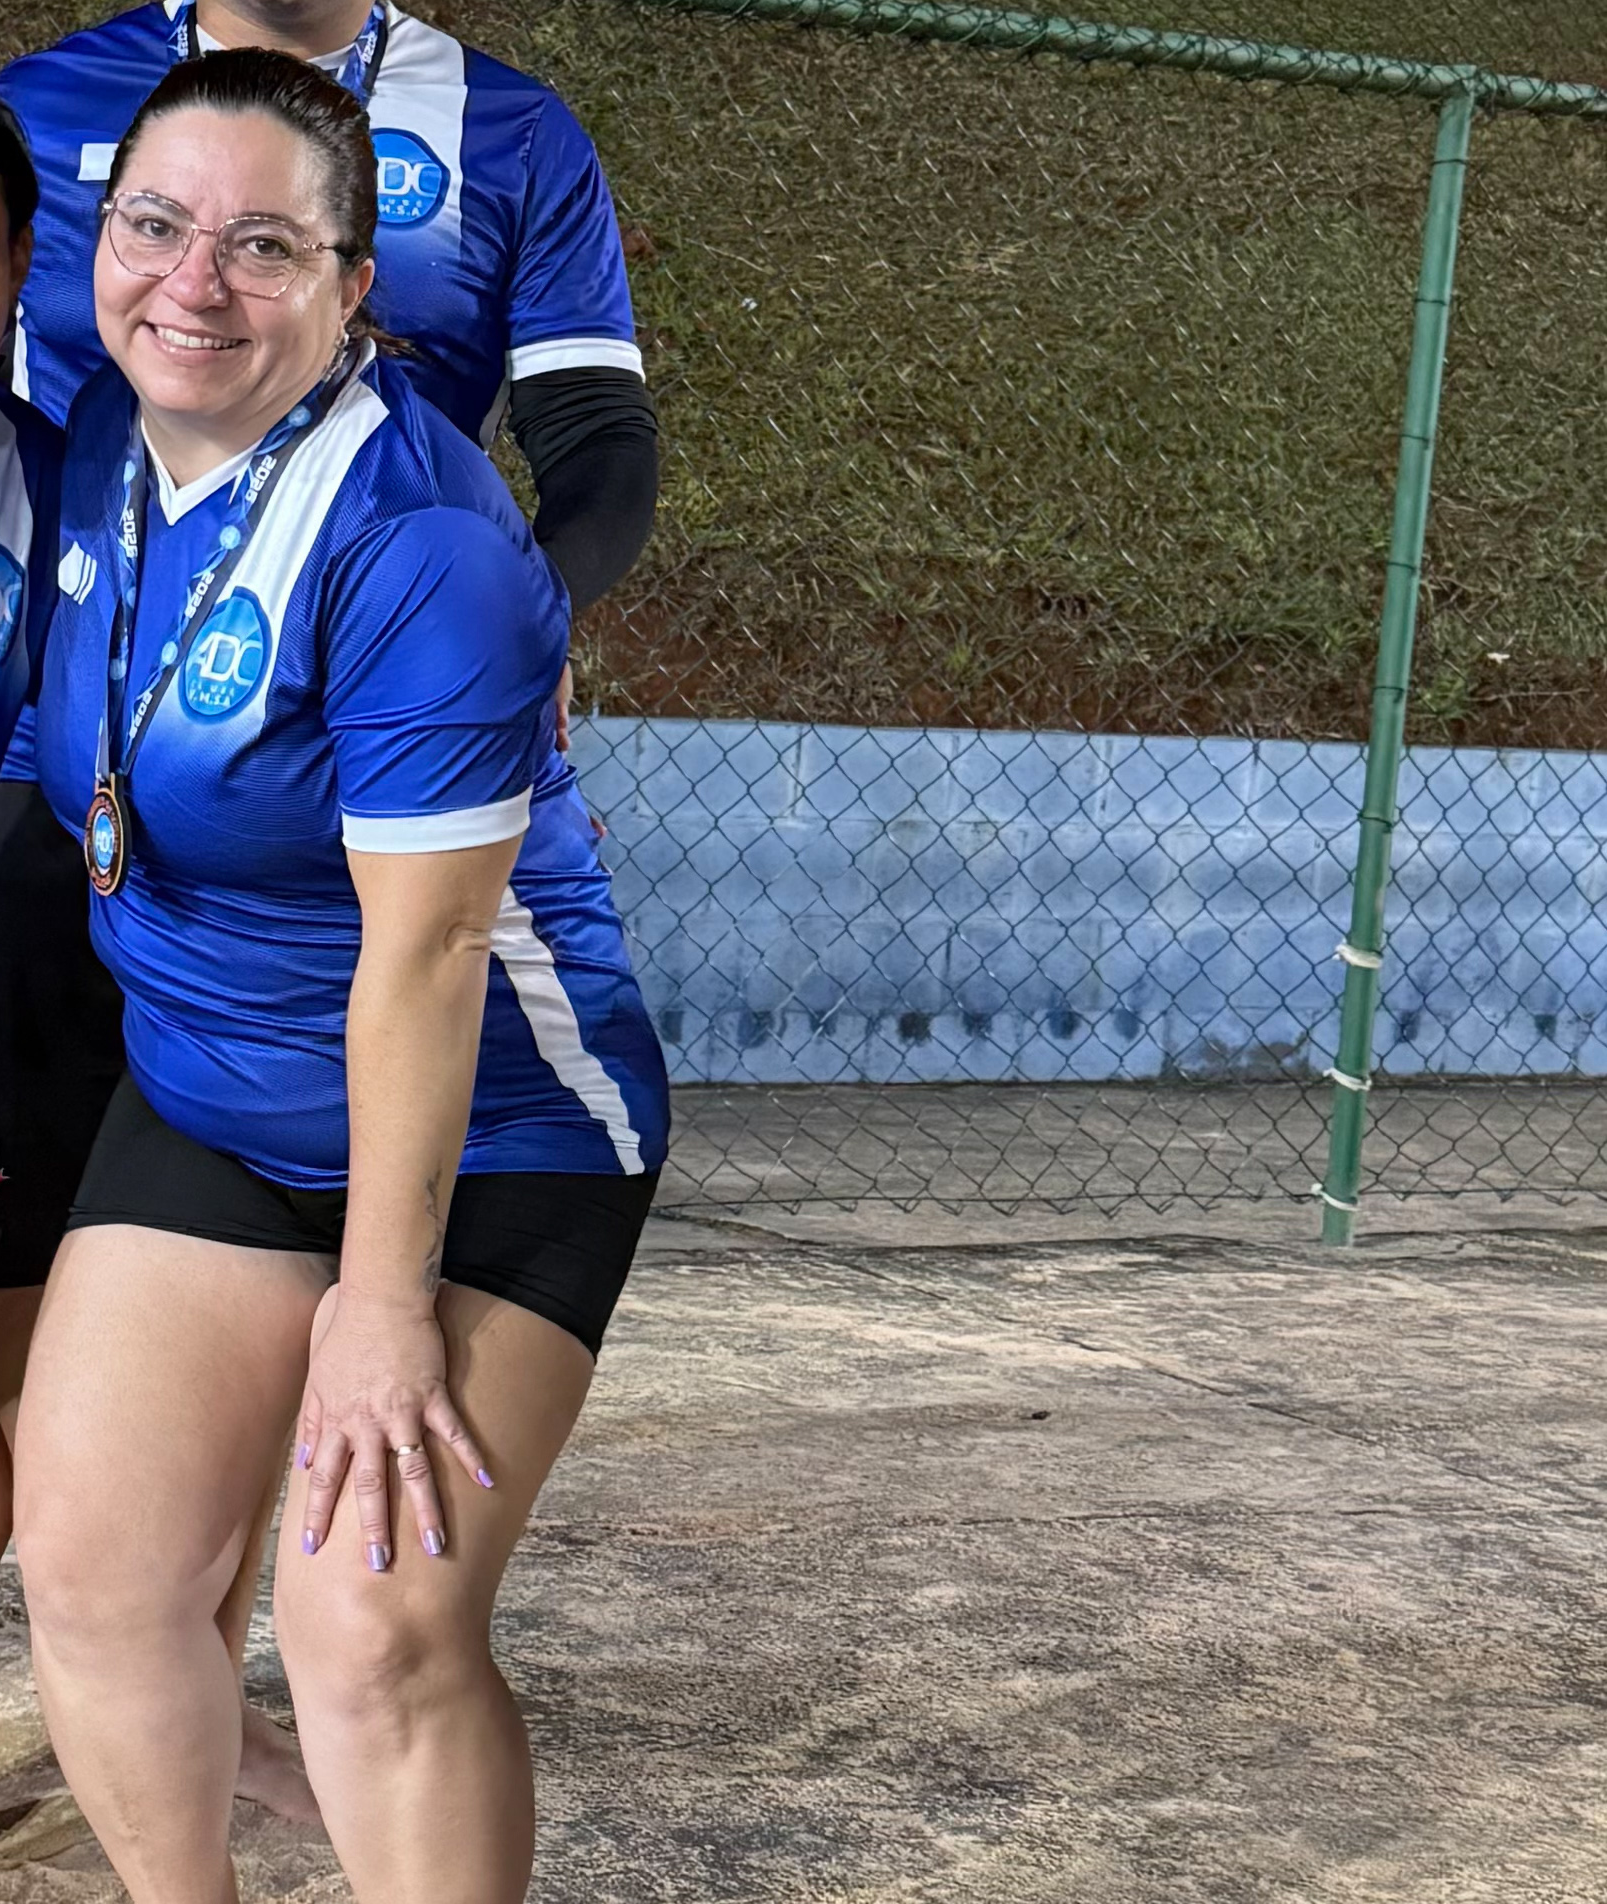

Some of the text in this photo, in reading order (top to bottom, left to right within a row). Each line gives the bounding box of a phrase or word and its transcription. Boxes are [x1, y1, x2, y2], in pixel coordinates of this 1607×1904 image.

[376, 156, 442, 199] DC
[244, 454, 278, 504] 2026
[123, 508, 139, 559] 2026
